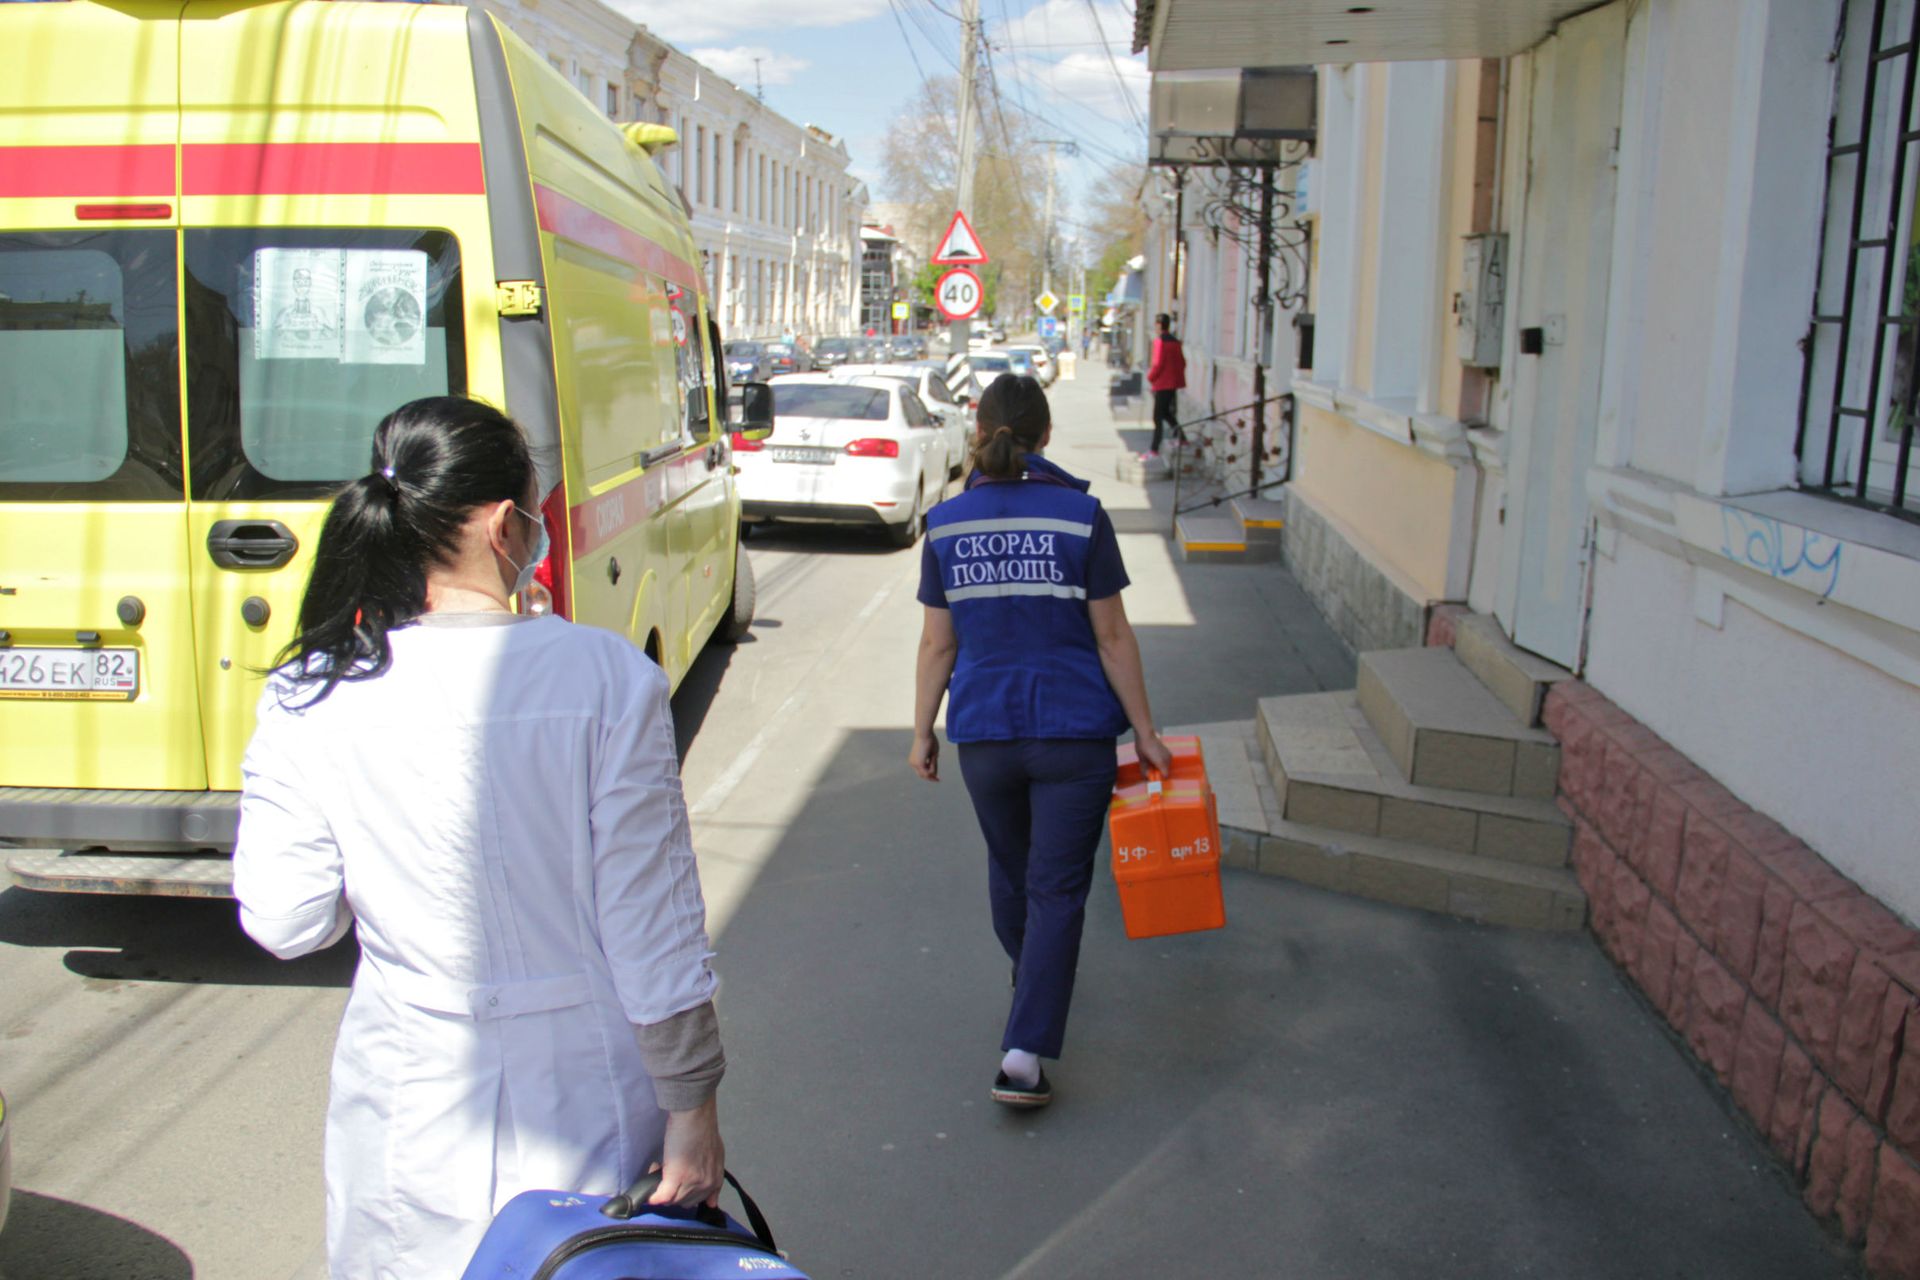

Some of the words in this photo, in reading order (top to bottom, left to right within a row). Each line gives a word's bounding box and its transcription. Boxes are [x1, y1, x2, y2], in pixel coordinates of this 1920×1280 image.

[945, 284, 973, 303] 40
[955, 533, 1055, 559] СКОРАЯ
[952, 560, 1064, 586] ПОМОЩЬ
[97, 654, 124, 676] 82
[95, 677, 116, 686] RUS
